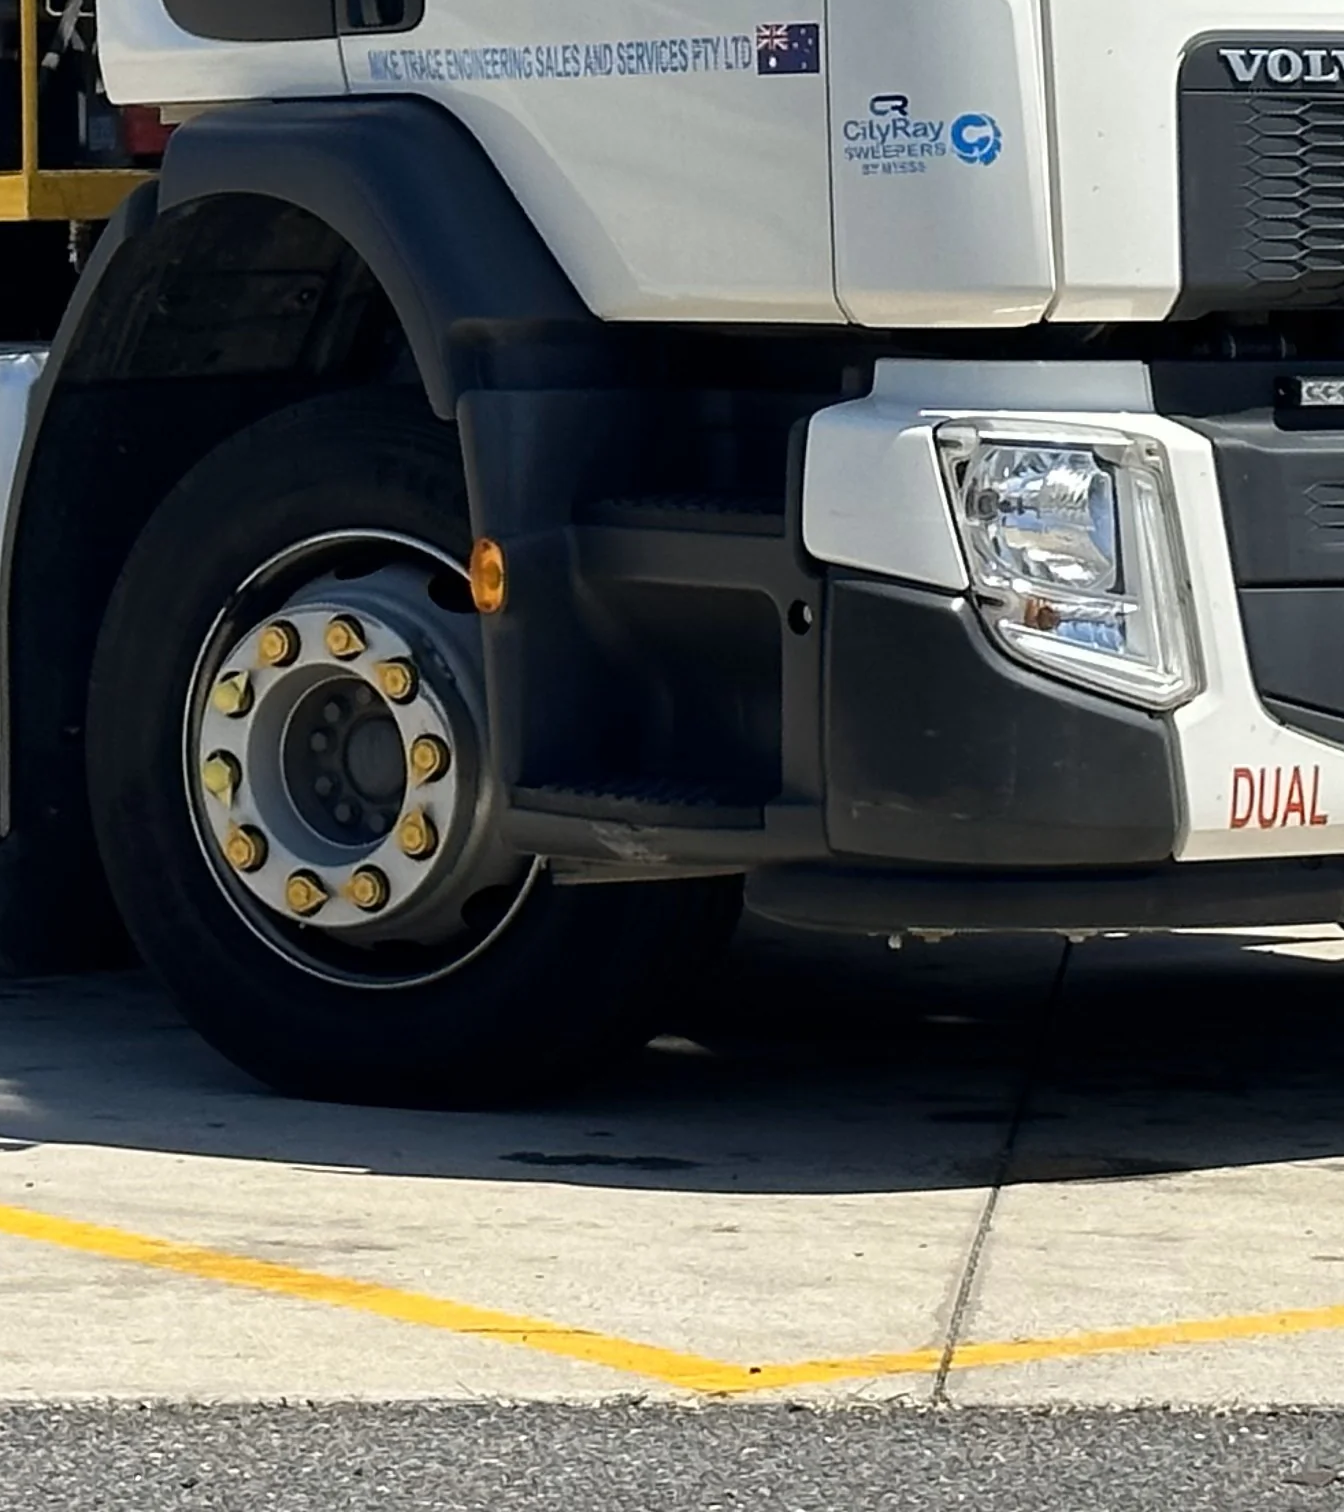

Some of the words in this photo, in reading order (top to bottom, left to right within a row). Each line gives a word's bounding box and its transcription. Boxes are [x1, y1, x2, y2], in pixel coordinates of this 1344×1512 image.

[367, 48, 403, 81] MIKE
[401, 48, 446, 81] TRACE
[446, 46, 533, 80] ENGINEERING
[535, 44, 580, 79] SALES
[583, 43, 614, 76] AND
[616, 38, 689, 76] SERVICES
[691, 36, 721, 72] PTY
[722, 35, 752, 70] LTD
[843, 118, 945, 145] CityRay
[844, 143, 946, 162] SWEEPERS
[1229, 763, 1329, 830] DUAL
